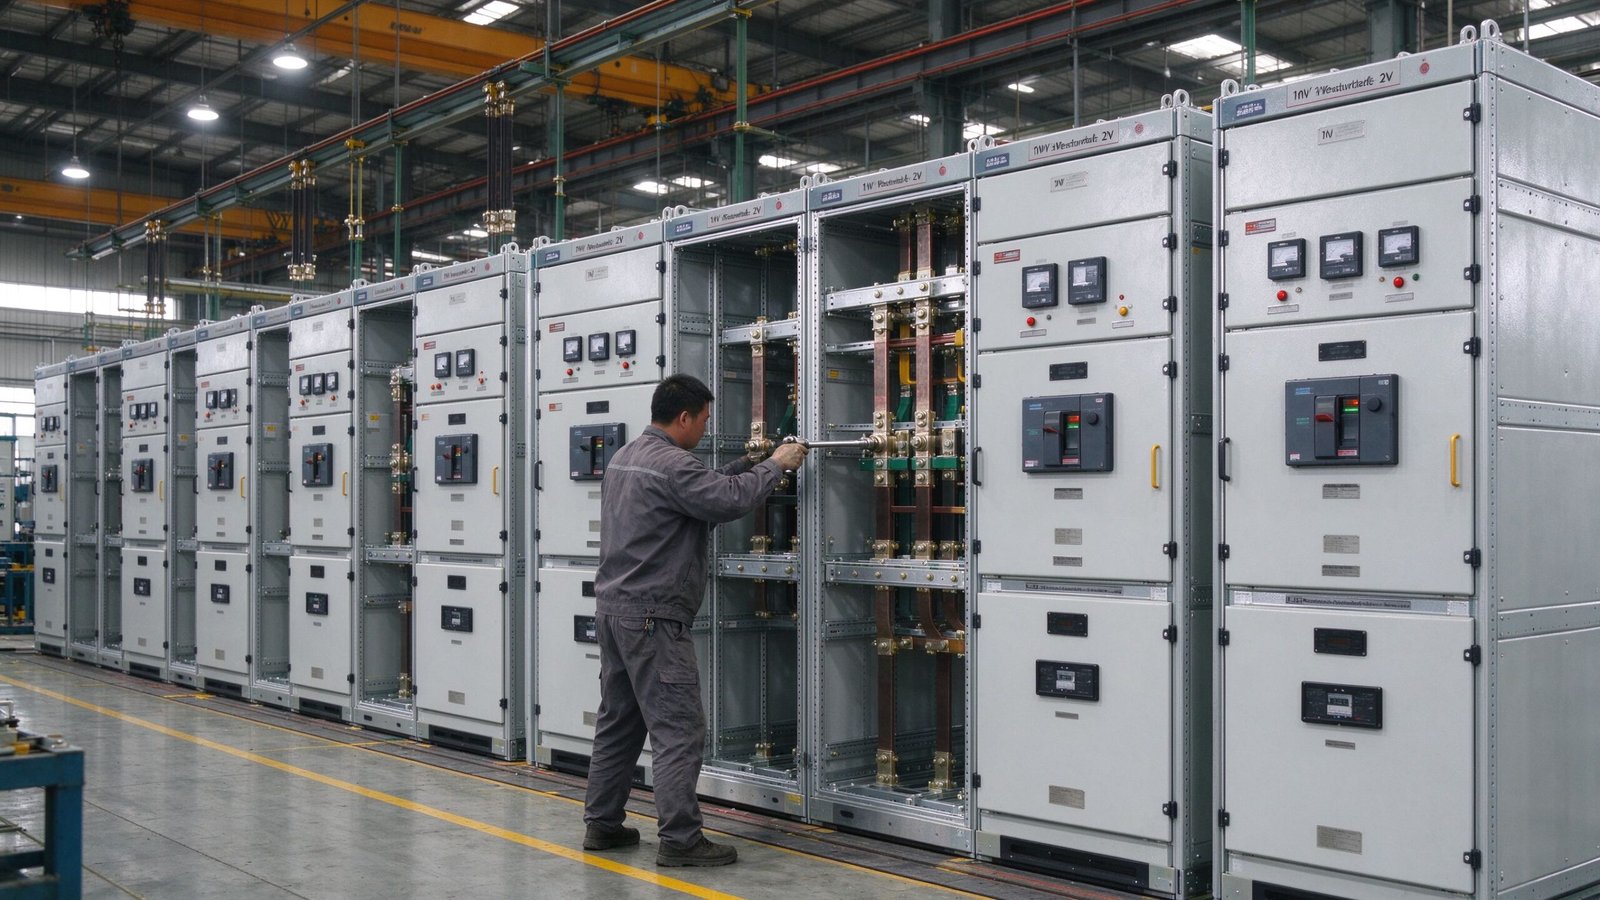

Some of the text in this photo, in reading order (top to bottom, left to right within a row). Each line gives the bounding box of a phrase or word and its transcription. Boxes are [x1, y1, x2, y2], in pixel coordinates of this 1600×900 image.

[1379, 71, 1394, 84] 2V
[1102, 130, 1114, 142] 2V
[912, 171, 922, 181] 2V
